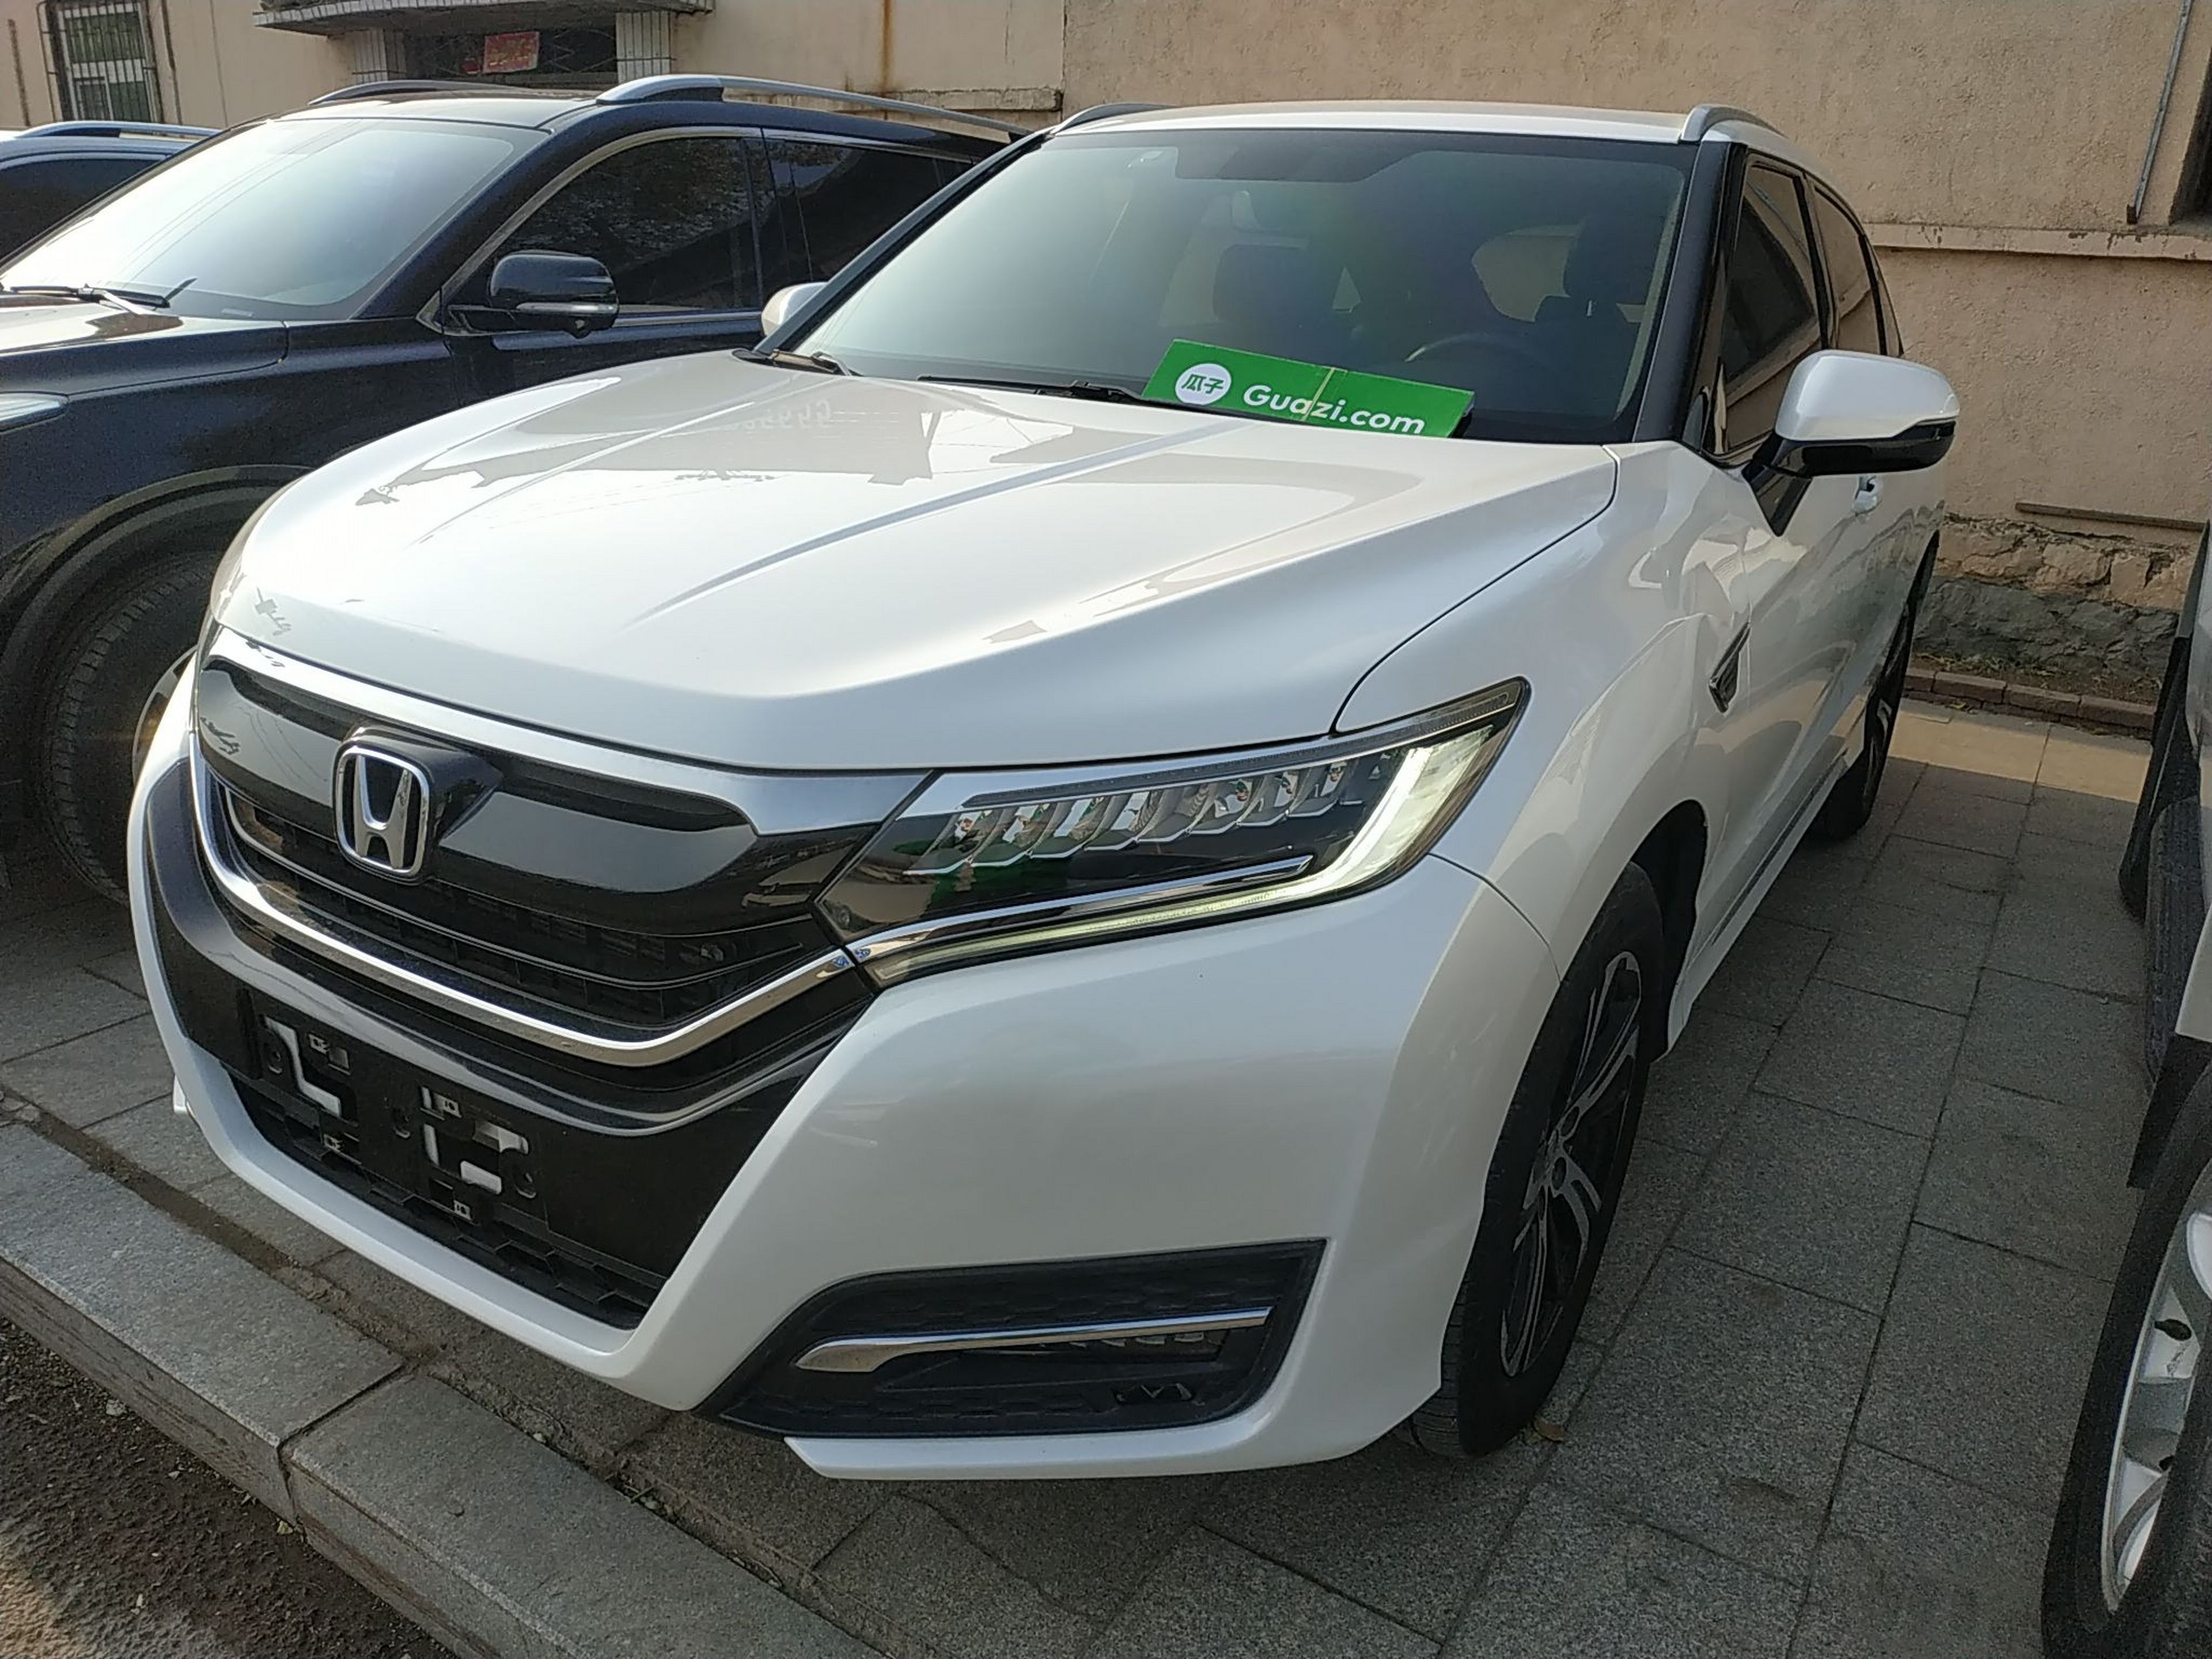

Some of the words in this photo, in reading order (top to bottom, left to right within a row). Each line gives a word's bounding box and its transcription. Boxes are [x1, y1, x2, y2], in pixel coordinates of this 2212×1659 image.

[1181, 373, 1224, 394] 瓜子
[1243, 385, 1425, 434] Guazi.com
[352, 752, 413, 870] H
